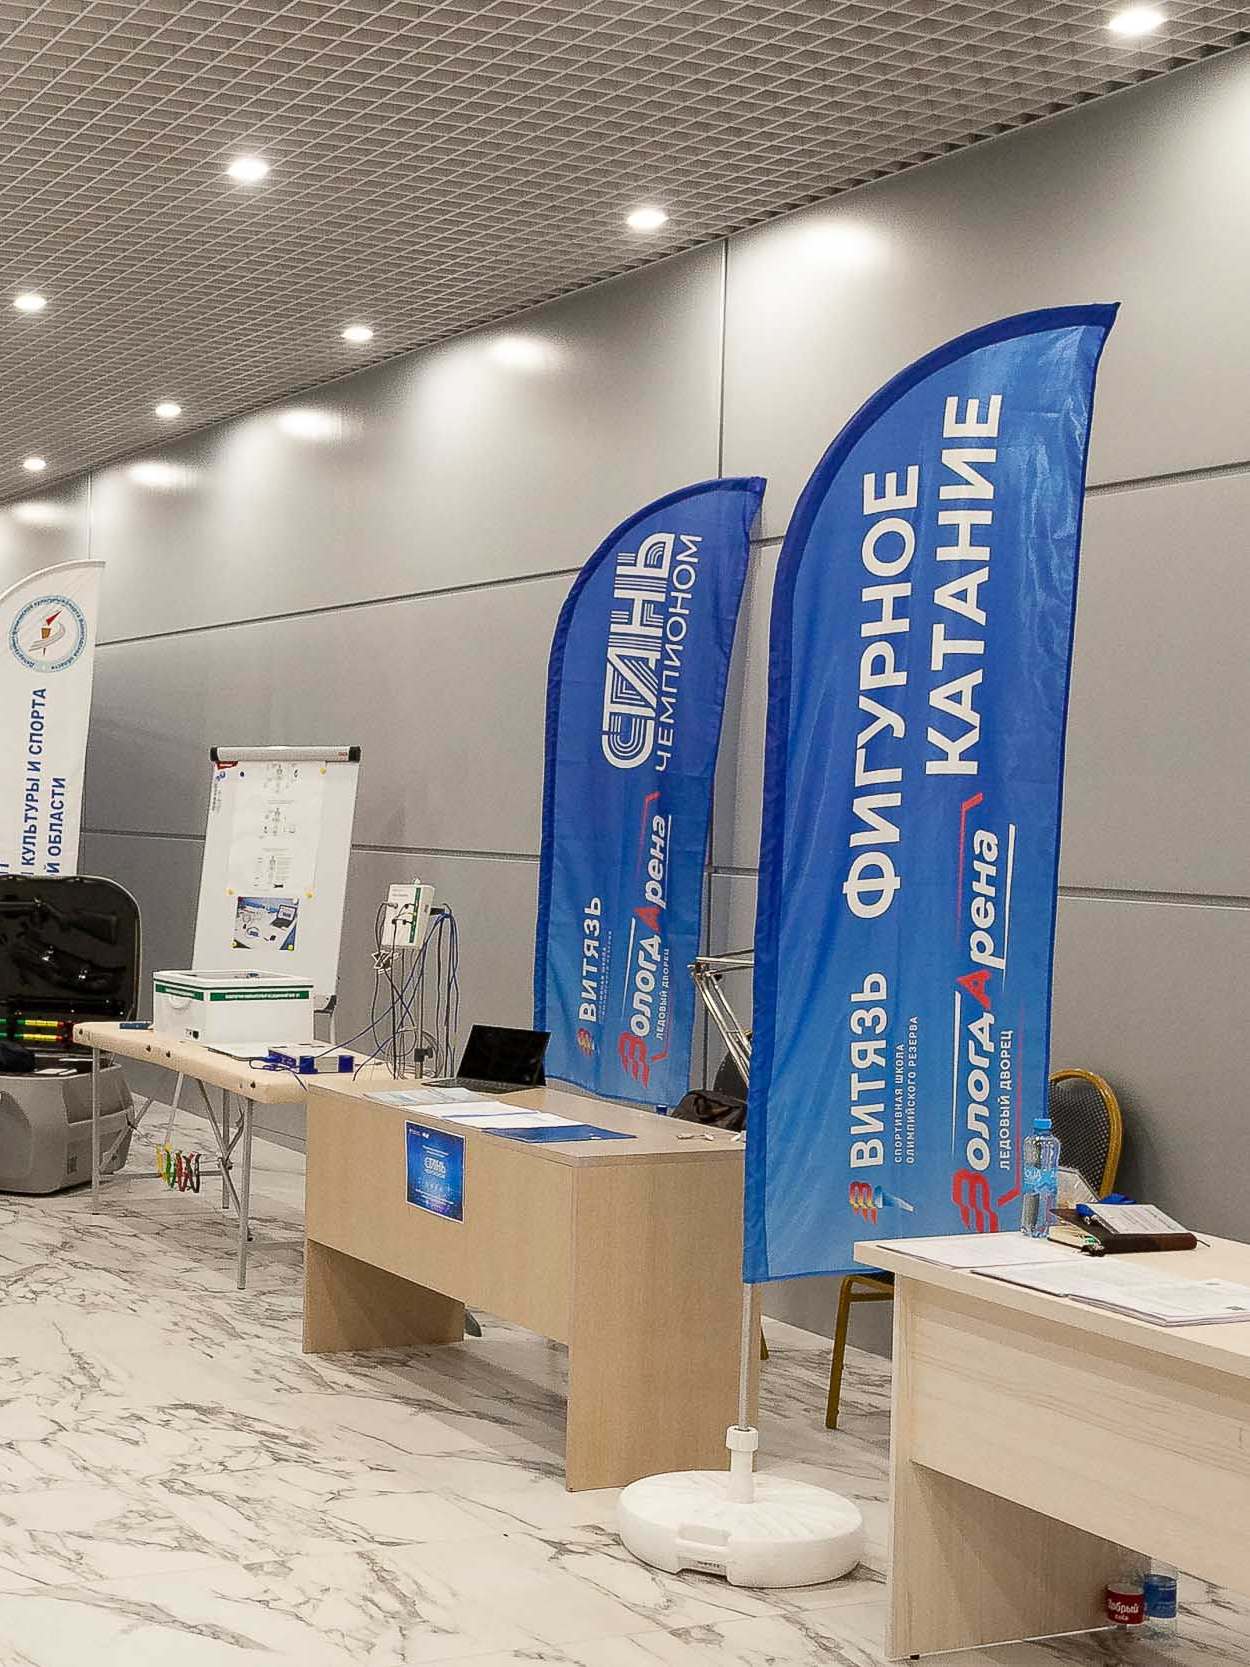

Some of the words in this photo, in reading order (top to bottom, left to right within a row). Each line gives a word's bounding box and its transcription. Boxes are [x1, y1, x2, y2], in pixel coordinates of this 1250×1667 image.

[925, 393, 1002, 776] КАТАНИЕ
[602, 531, 675, 769] СТАНЬ
[654, 533, 703, 771] ЧЕМПИОНОМ
[28, 687, 47, 756] СПОРТА
[843, 464, 919, 919] ФИГУРНОЕ
[27, 761, 42, 774] И
[21, 779, 40, 866] КУЛЬТУРЫ
[47, 777, 66, 857] ОБЛАСТИ
[579, 897, 601, 1022] ВИТЯЗЬ
[655, 990, 668, 1040] ЛЕДОВЫЙ
[907, 1016, 918, 1068] РЕЗЕРВА
[850, 971, 888, 1168] ВИТЯЗЬ
[894, 1043, 904, 1083] ШКОЛА
[999, 1030, 1014, 1090] ДВОРЕЦ
[894, 1086, 904, 1164] СПОРТИВНАЯ
[905, 1071, 917, 1164] ОЛИМПИЙСКОГО
[997, 1098, 1010, 1171] ЛЕДОВЫЙ
